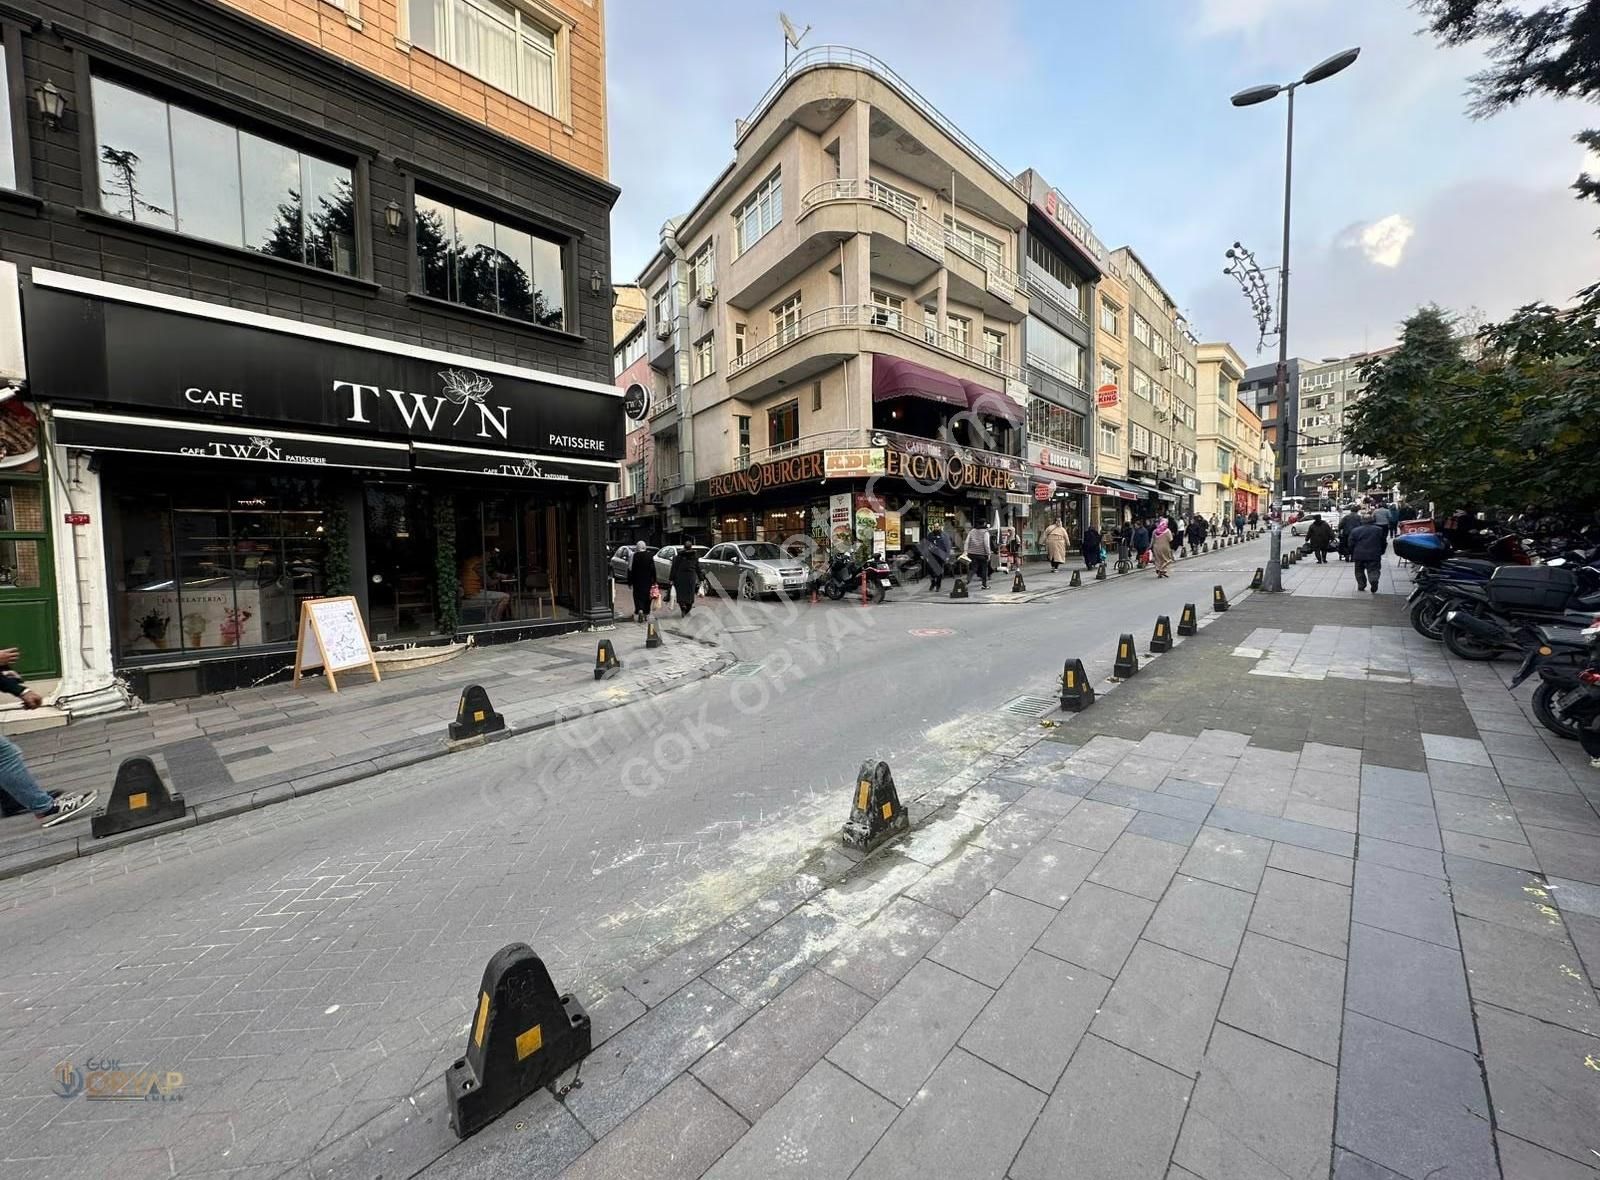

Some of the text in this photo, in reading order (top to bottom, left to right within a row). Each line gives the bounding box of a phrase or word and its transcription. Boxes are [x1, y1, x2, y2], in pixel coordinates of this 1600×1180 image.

[184, 387, 244, 409] CAFE
[1098, 394, 1117, 403] KING
[549, 433, 606, 452] PATISSERIE
[180, 447, 206, 456] CAFE
[285, 454, 327, 465] PATISSERIE
[483, 467, 498, 475] CAFE
[709, 453, 822, 497] ERCAN BURGER
[886, 450, 1010, 488] ERCAN BURGER
